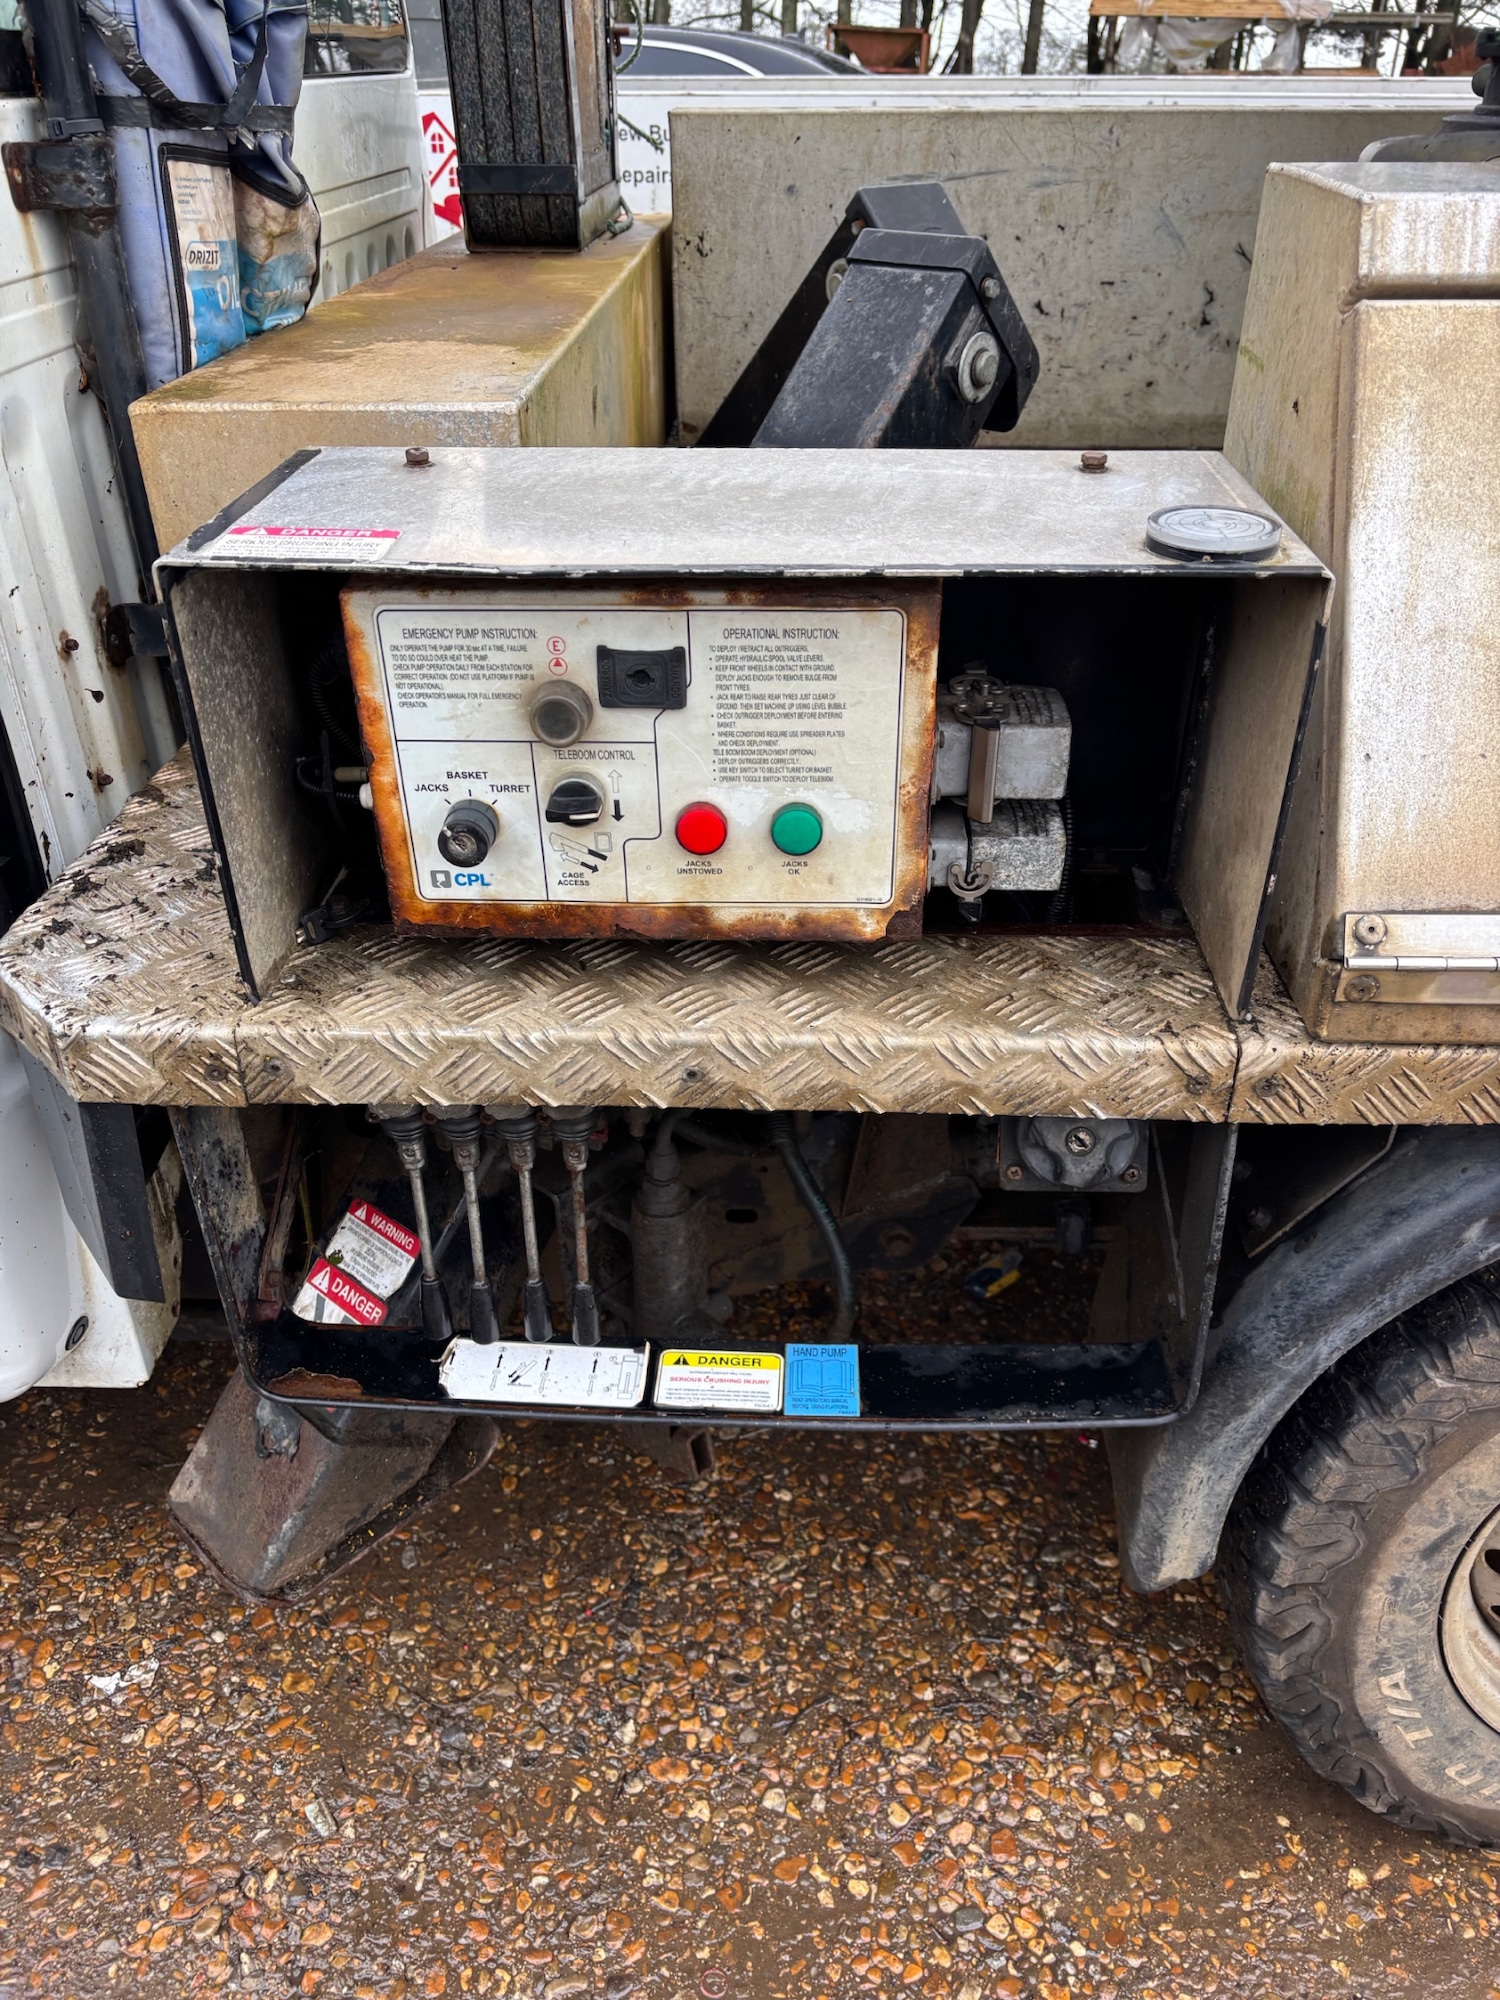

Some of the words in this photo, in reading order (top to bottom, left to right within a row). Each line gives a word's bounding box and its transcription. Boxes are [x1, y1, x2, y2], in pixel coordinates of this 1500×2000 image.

[619, 128, 640, 141] ew
[650, 125, 670, 141] Bu
[620, 166, 671, 188] epair
[188, 250, 219, 266] DRIZIT
[280, 528, 373, 537] DANGER
[402, 628, 453, 639] EMERGENCY
[456, 628, 479, 639] PUMP
[481, 628, 538, 639] INSTRUCTION:
[723, 628, 780, 639] OPERATIONAL
[782, 629, 839, 640] INSTRUCTION:
[553, 750, 596, 760] TELEBOOM
[598, 750, 635, 760] CONTROL
[414, 784, 449, 792] JACKS
[489, 784, 530, 793] TURRET
[454, 873, 491, 886] CPL
[370, 1212, 415, 1250] WARNING
[330, 1278, 382, 1324] DANGER
[793, 1347, 818, 1356] HAND
[821, 1348, 847, 1357] PUMP
[698, 1356, 762, 1366] DANGER
